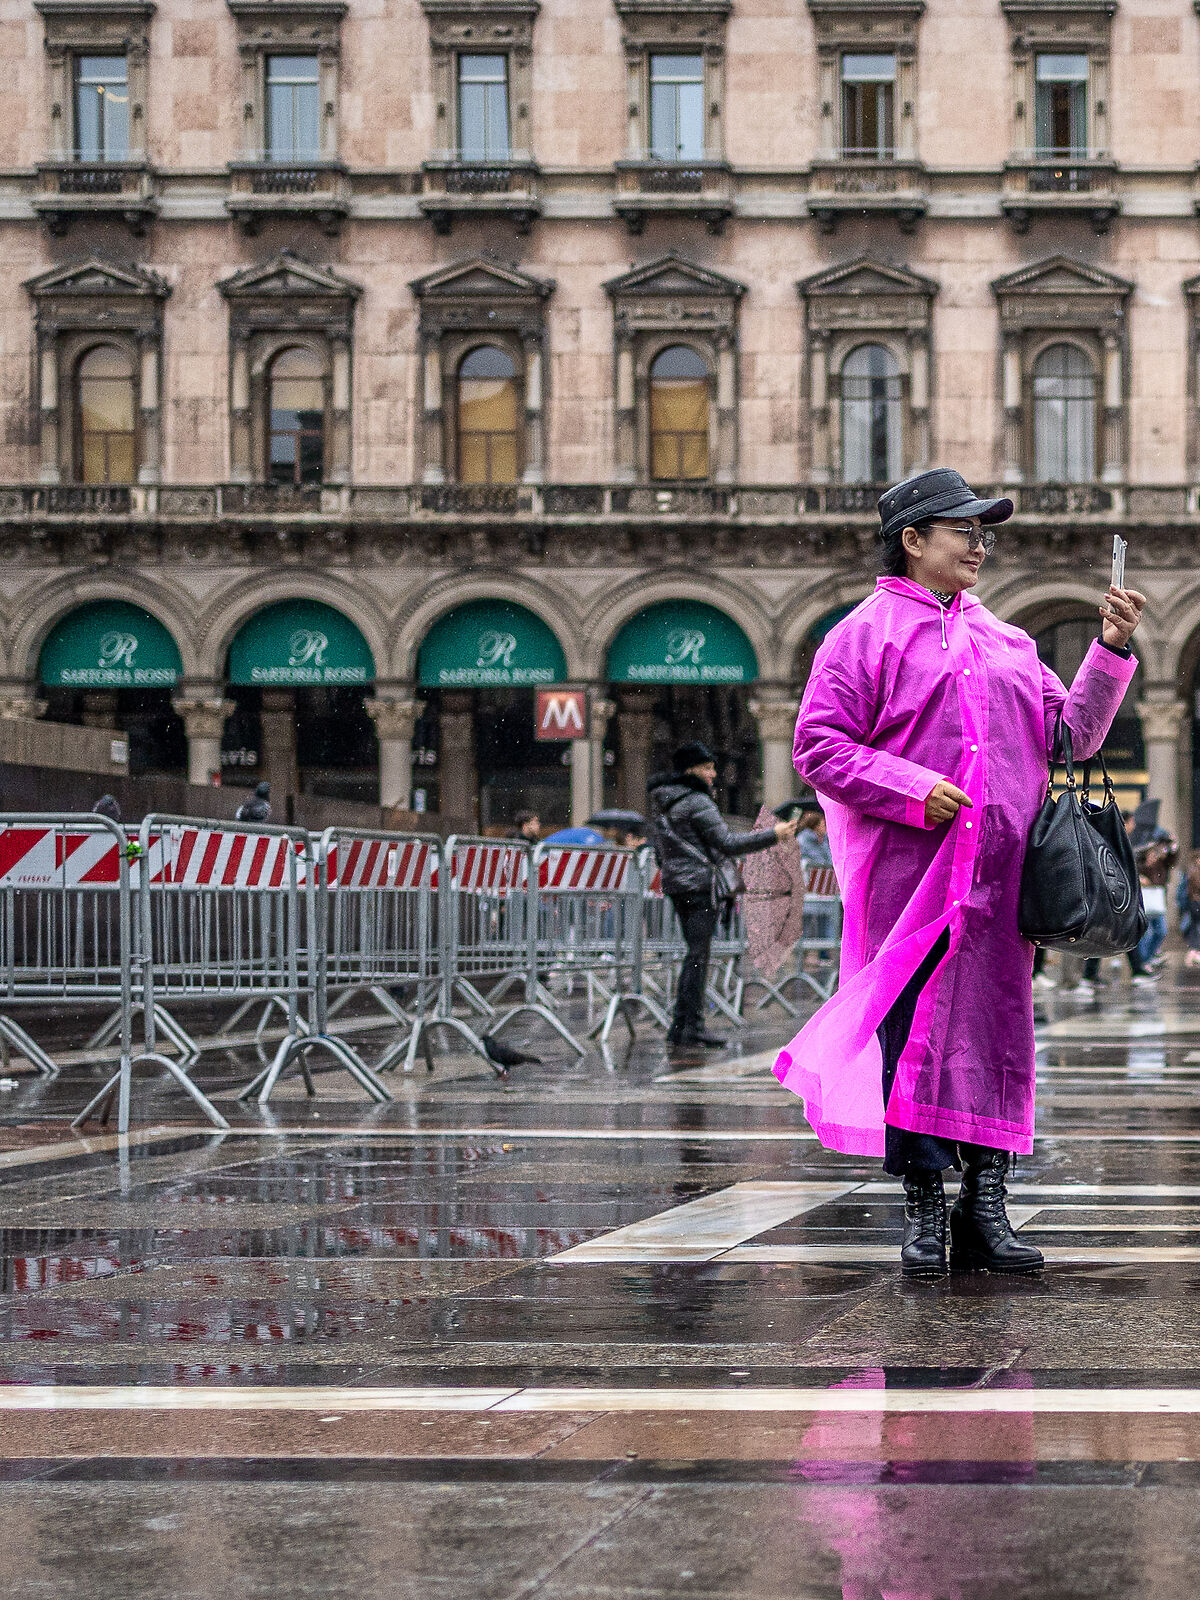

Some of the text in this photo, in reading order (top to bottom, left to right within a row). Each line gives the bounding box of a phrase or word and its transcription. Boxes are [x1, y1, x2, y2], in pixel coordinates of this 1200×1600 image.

[60, 669, 177, 684] SARTORIA ROSSI
[251, 667, 366, 682] SARTORIA ROSSI
[438, 667, 555, 683] SARTORIA ROSSI
[627, 665, 744, 680] SARTORIA ROSSI
[541, 697, 583, 730] M
